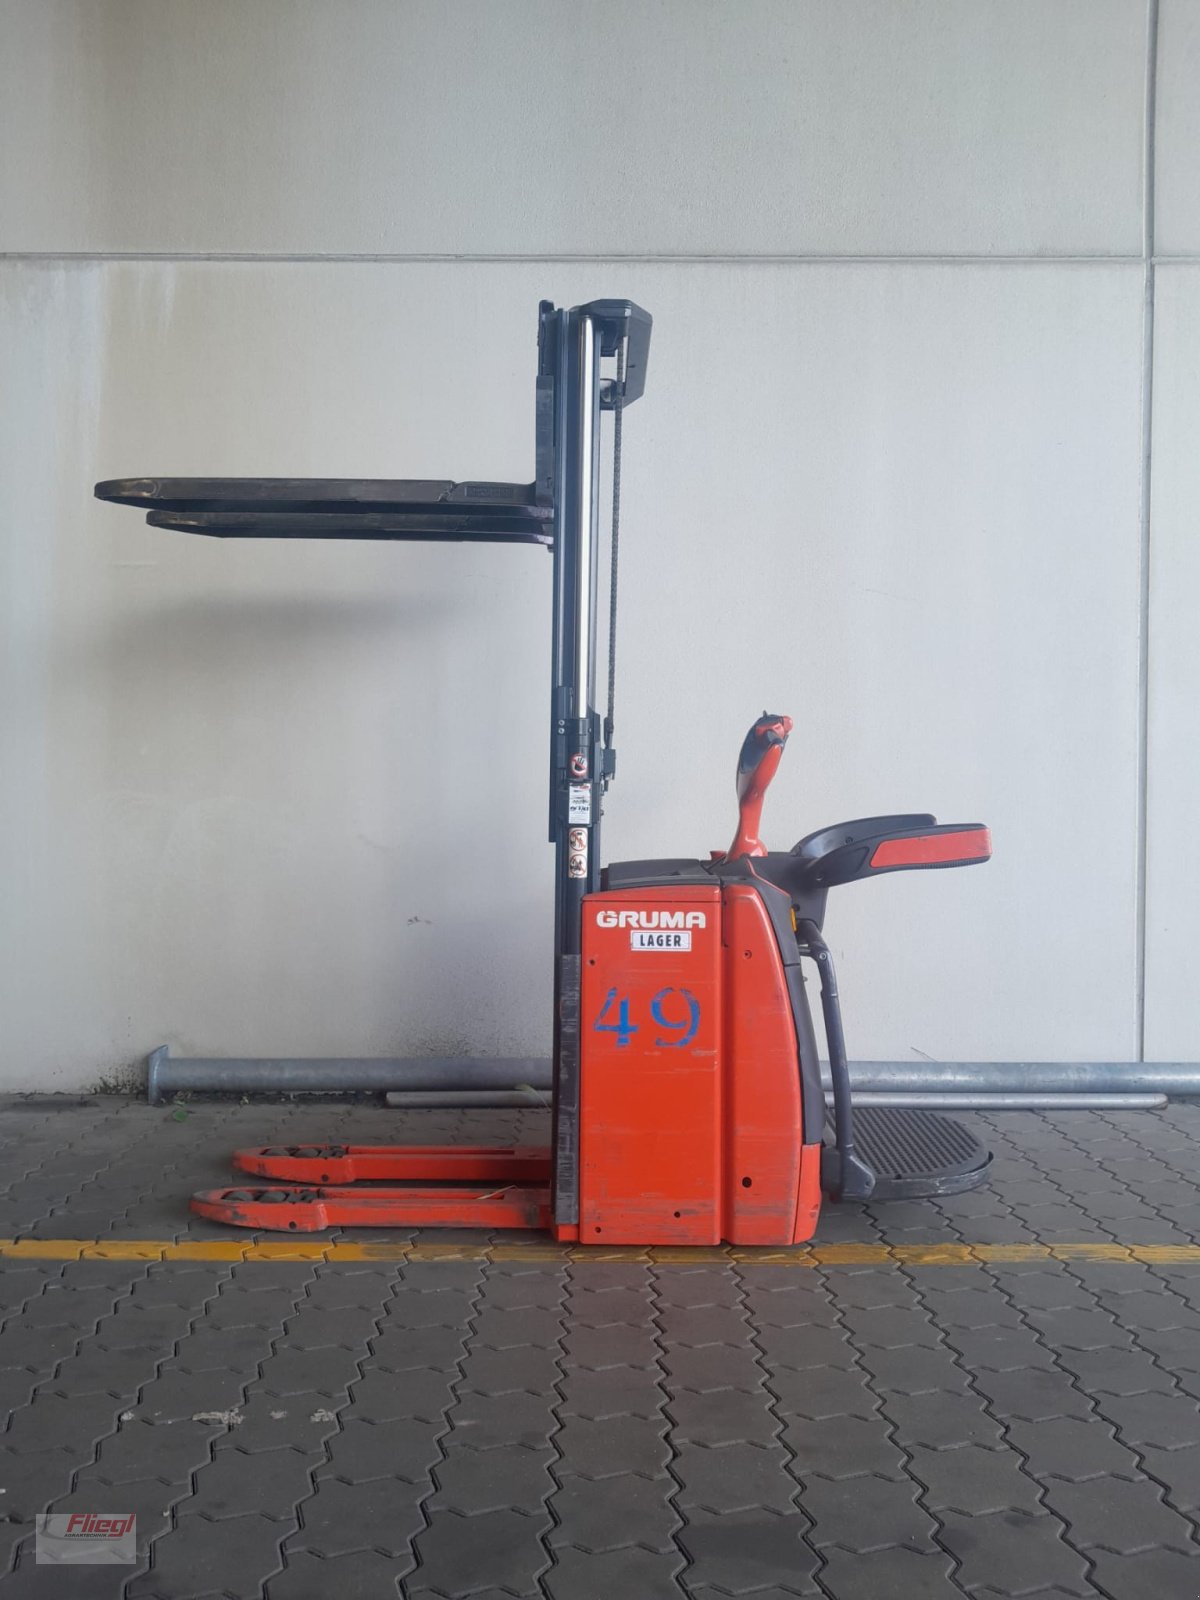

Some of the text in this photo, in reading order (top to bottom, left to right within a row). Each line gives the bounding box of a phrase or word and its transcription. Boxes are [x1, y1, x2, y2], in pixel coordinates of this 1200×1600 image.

[596, 911, 706, 929] GRUMA
[639, 934, 682, 947] LAGER
[593, 987, 701, 1048] 49
